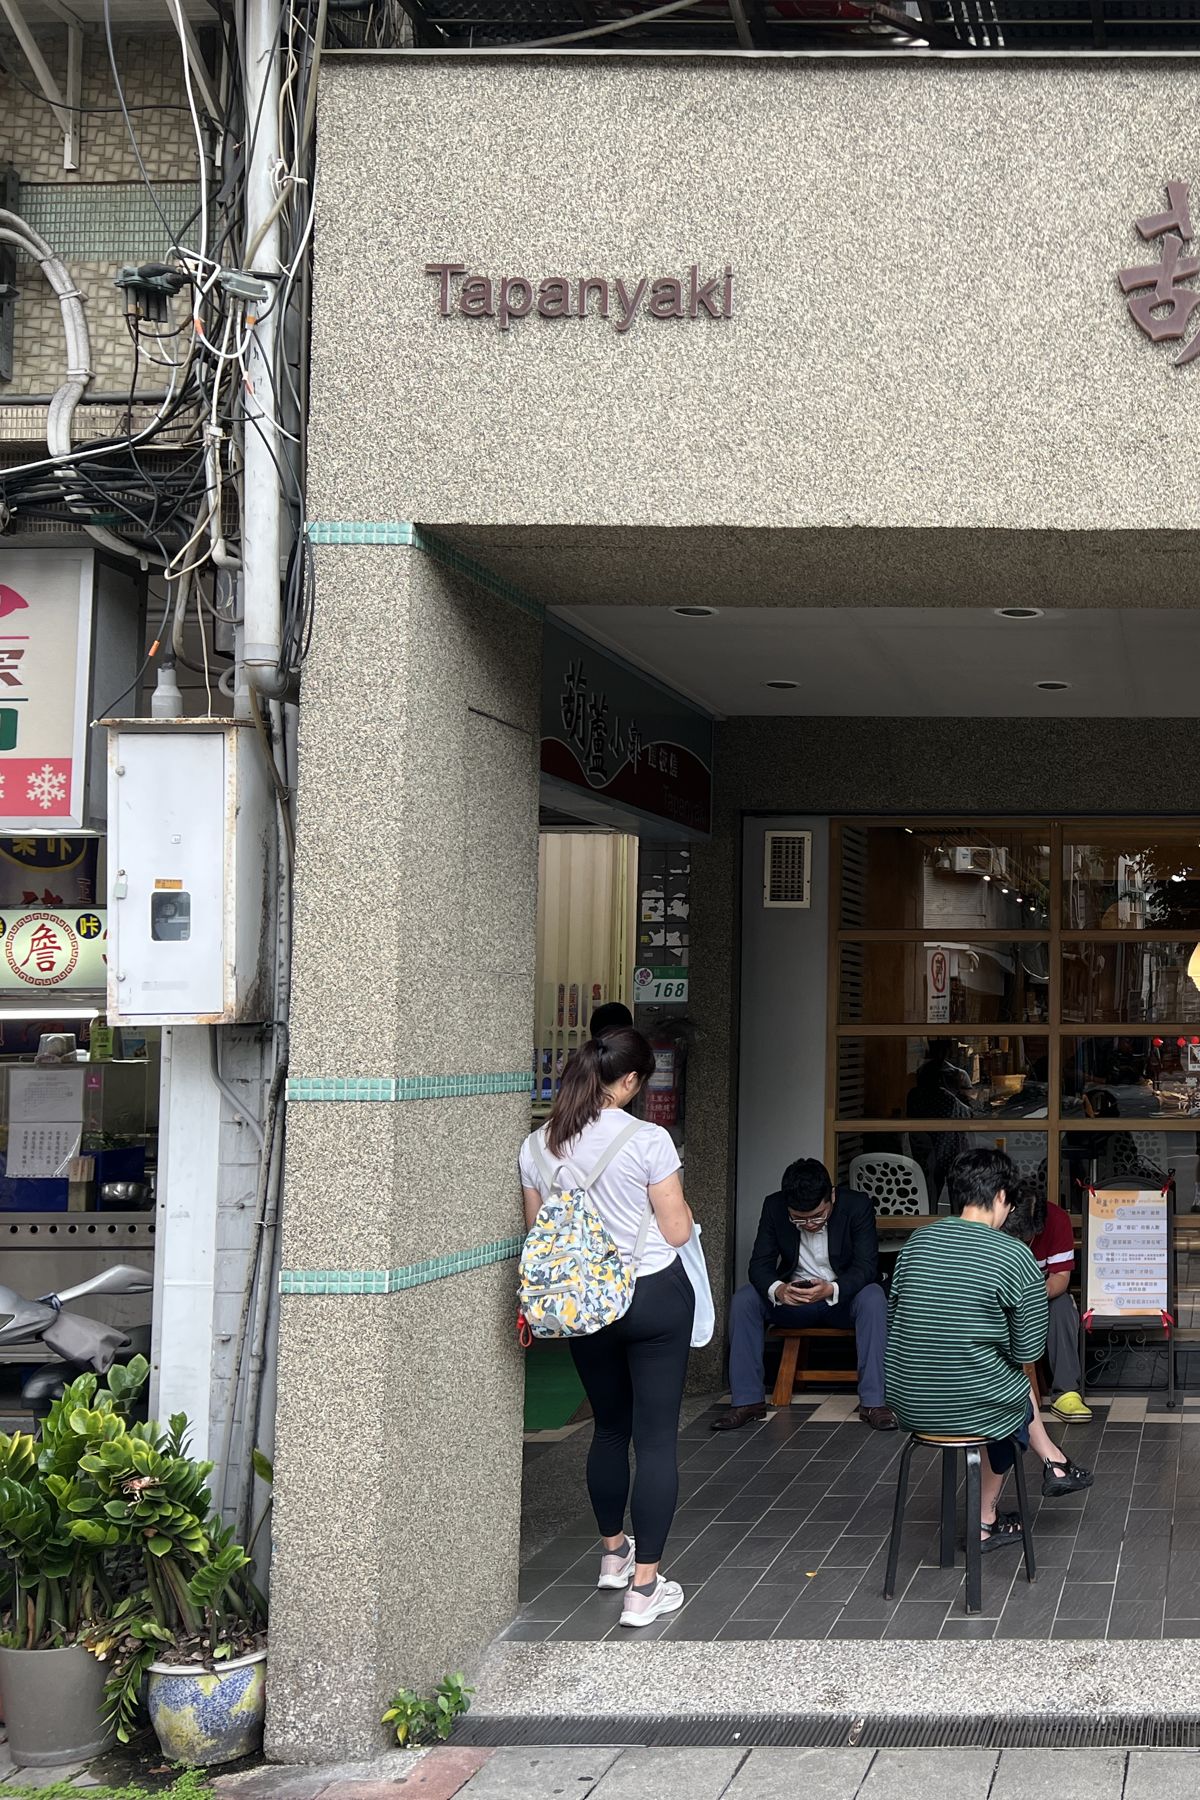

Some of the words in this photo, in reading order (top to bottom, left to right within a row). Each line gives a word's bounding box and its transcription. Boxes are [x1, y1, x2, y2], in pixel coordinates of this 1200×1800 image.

[425, 263, 736, 331] Tapanyaki
[19, 923, 62, 973] 詹
[654, 982, 685, 998] 168
